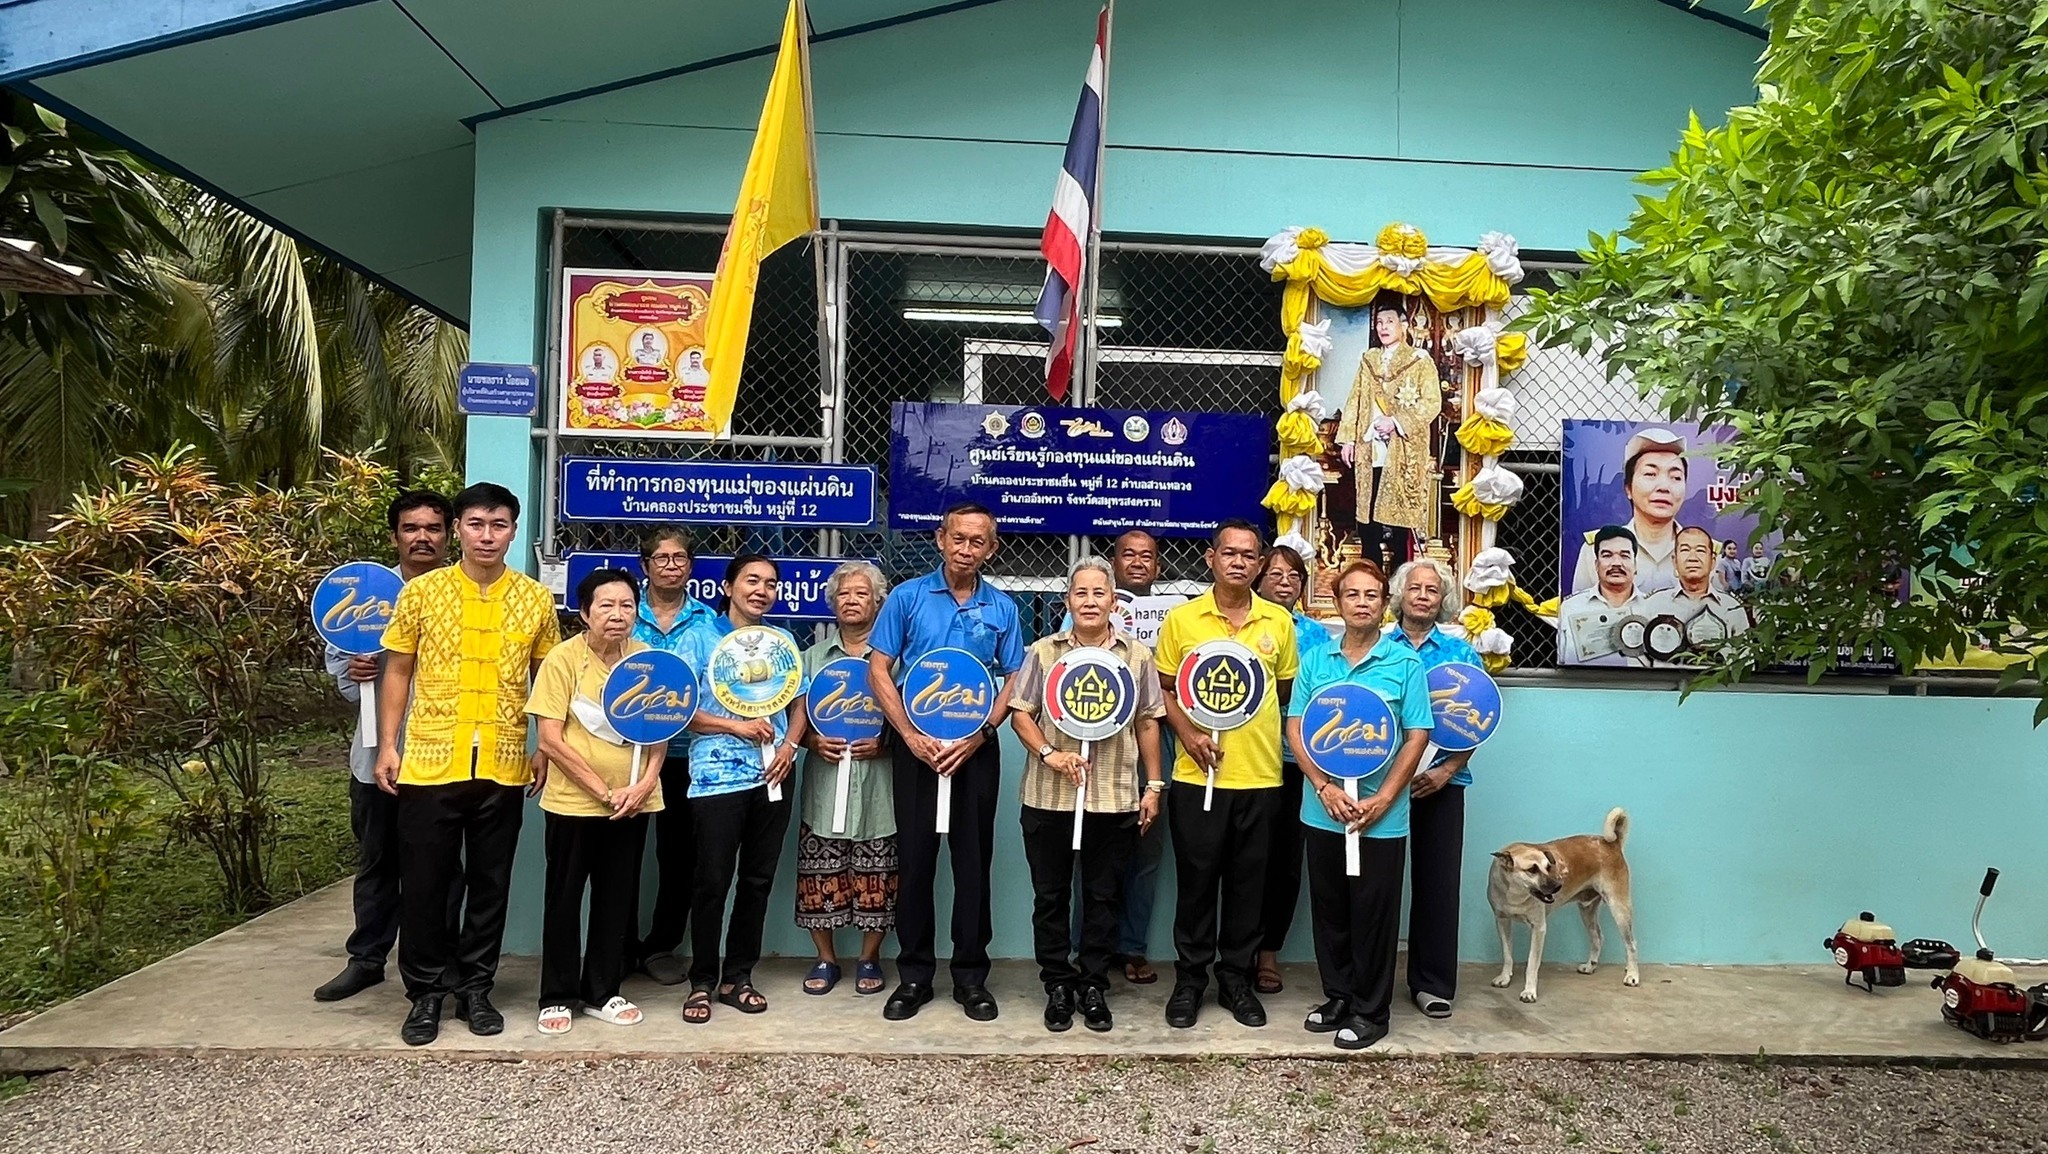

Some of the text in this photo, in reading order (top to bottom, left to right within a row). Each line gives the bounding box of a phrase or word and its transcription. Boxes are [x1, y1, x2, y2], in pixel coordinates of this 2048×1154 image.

[969, 445, 1195, 469] ศูนย์เรียนรู้กองทุนแม่ของแผ่นดิน
[586, 466, 853, 500] ที่ทำการกองทุนแม่ของแผ่นดิน
[970, 473, 1192, 493] บ้านคลองประชาชมชื่น หมู่ที่ 12 ตำบลสวนหลวง
[622, 496, 818, 520] บ้านคลองประชาชมชื่น หมู่ที่ 12
[1001, 491, 1162, 509] อำเภออัมพวา จังหวัดสมุทรสงคราม
[1136, 627, 1153, 640] for
[1882, 646, 1895, 657] 12
[719, 679, 796, 716] จังหวัดสมุทรสงคราม
